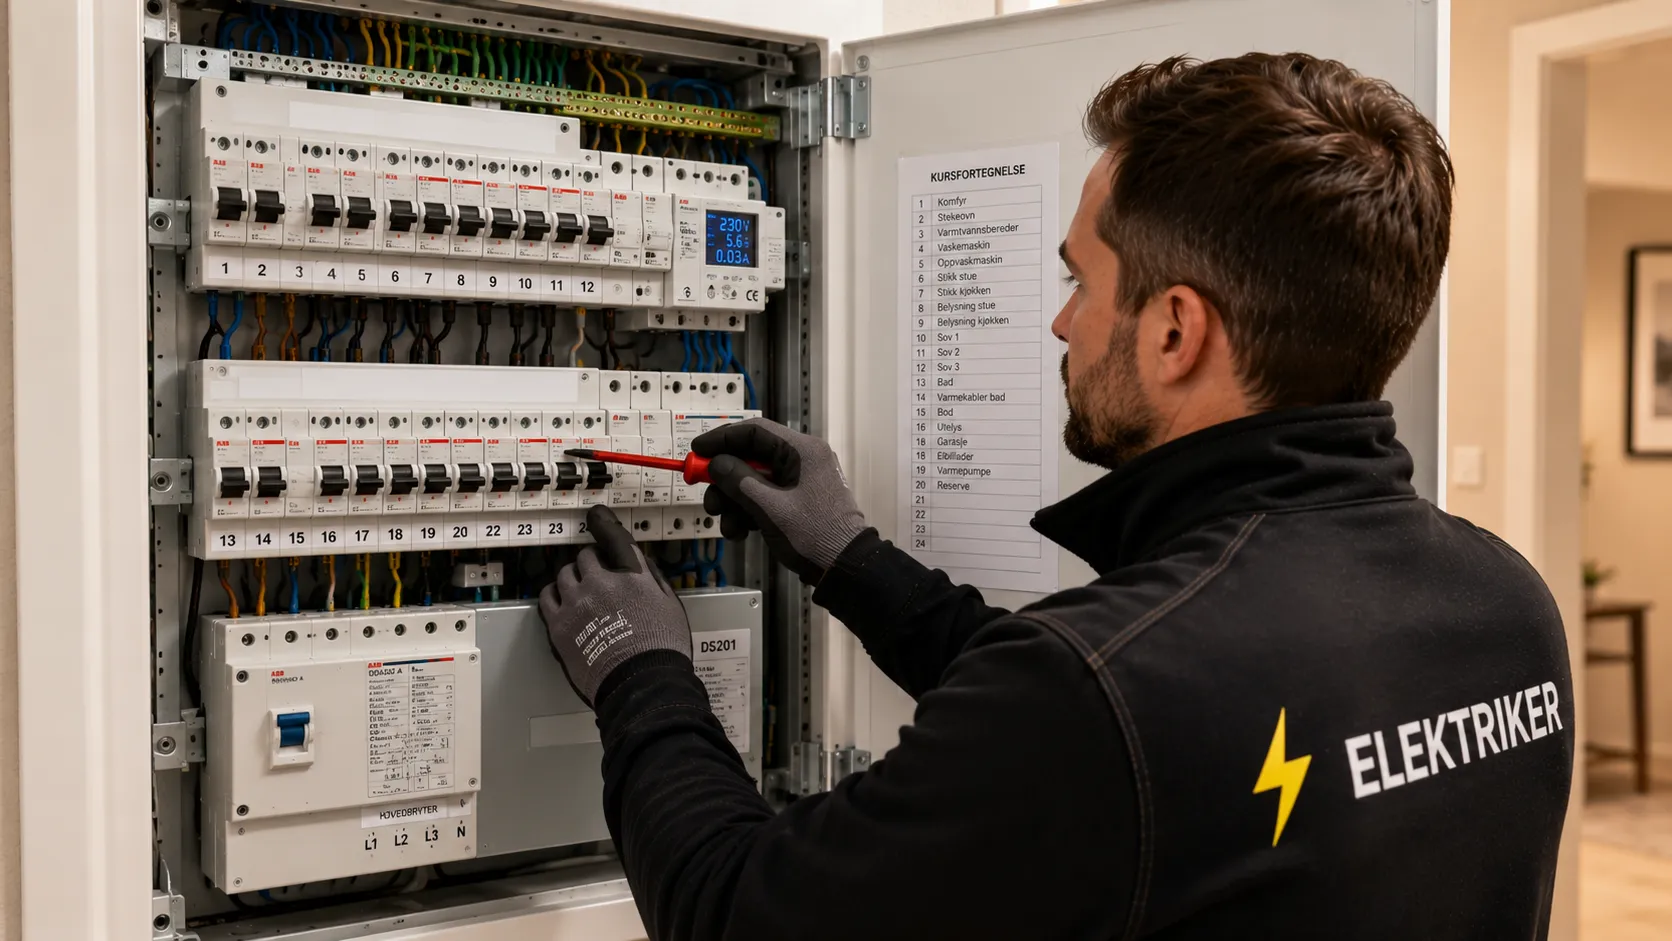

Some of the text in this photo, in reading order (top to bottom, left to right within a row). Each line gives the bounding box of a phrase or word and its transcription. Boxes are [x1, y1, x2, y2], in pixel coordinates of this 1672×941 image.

[931, 164, 1026, 182] KURSFORTEGNELSE
[937, 196, 967, 206] Komfyr
[918, 212, 976, 223] 2 Stekeovn
[719, 217, 751, 233] 230V
[918, 224, 1020, 238] 3 Varmtvannsbereder
[726, 233, 743, 248] 5.6
[918, 241, 991, 252] 4 Vaskemaskin
[716, 249, 750, 265] 0.03A
[918, 255, 1003, 268] 5 Oppvaskmaskin
[221, 262, 595, 293] 1 2 3 4 5 6 7 8 9 10 11 12
[918, 274, 925, 283] 6
[959, 272, 978, 280] stue
[918, 288, 924, 297] 7
[918, 301, 996, 312] 8 Belysning stue
[918, 318, 925, 327] 9
[937, 317, 976, 328] Belysning
[916, 333, 927, 342] 10
[937, 332, 953, 341] Sov
[916, 347, 960, 357] 11 Sov 2
[916, 362, 960, 372] 12 Sov 3
[916, 377, 954, 386] 13 Bad
[916, 392, 1006, 401] 14 Varmekabler bad
[916, 407, 954, 416] 15 Bod
[916, 422, 963, 433] 16 Utelys
[916, 437, 968, 448] 18 Garasje
[916, 451, 926, 460] 18
[916, 465, 992, 477] 19 Varmepumpe
[915, 480, 970, 490] 20 Reserve
[915, 495, 925, 504] 21
[915, 509, 926, 518] 22
[915, 524, 926, 533] 23
[219, 534, 236, 547] 13
[255, 532, 272, 546] 14
[288, 531, 305, 545] 15
[321, 530, 337, 544] 16
[354, 529, 370, 542] 17
[387, 527, 403, 541] 18
[420, 527, 436, 539] 19
[452, 525, 468, 539] 20
[485, 524, 501, 537] 22
[517, 523, 533, 536] 23
[548, 522, 564, 535] 23
[915, 538, 926, 547] 24
[700, 639, 736, 652] DS201
[1345, 681, 1562, 799] ELEKTRIKER
[364, 825, 466, 850] L1 L2 L3 N
